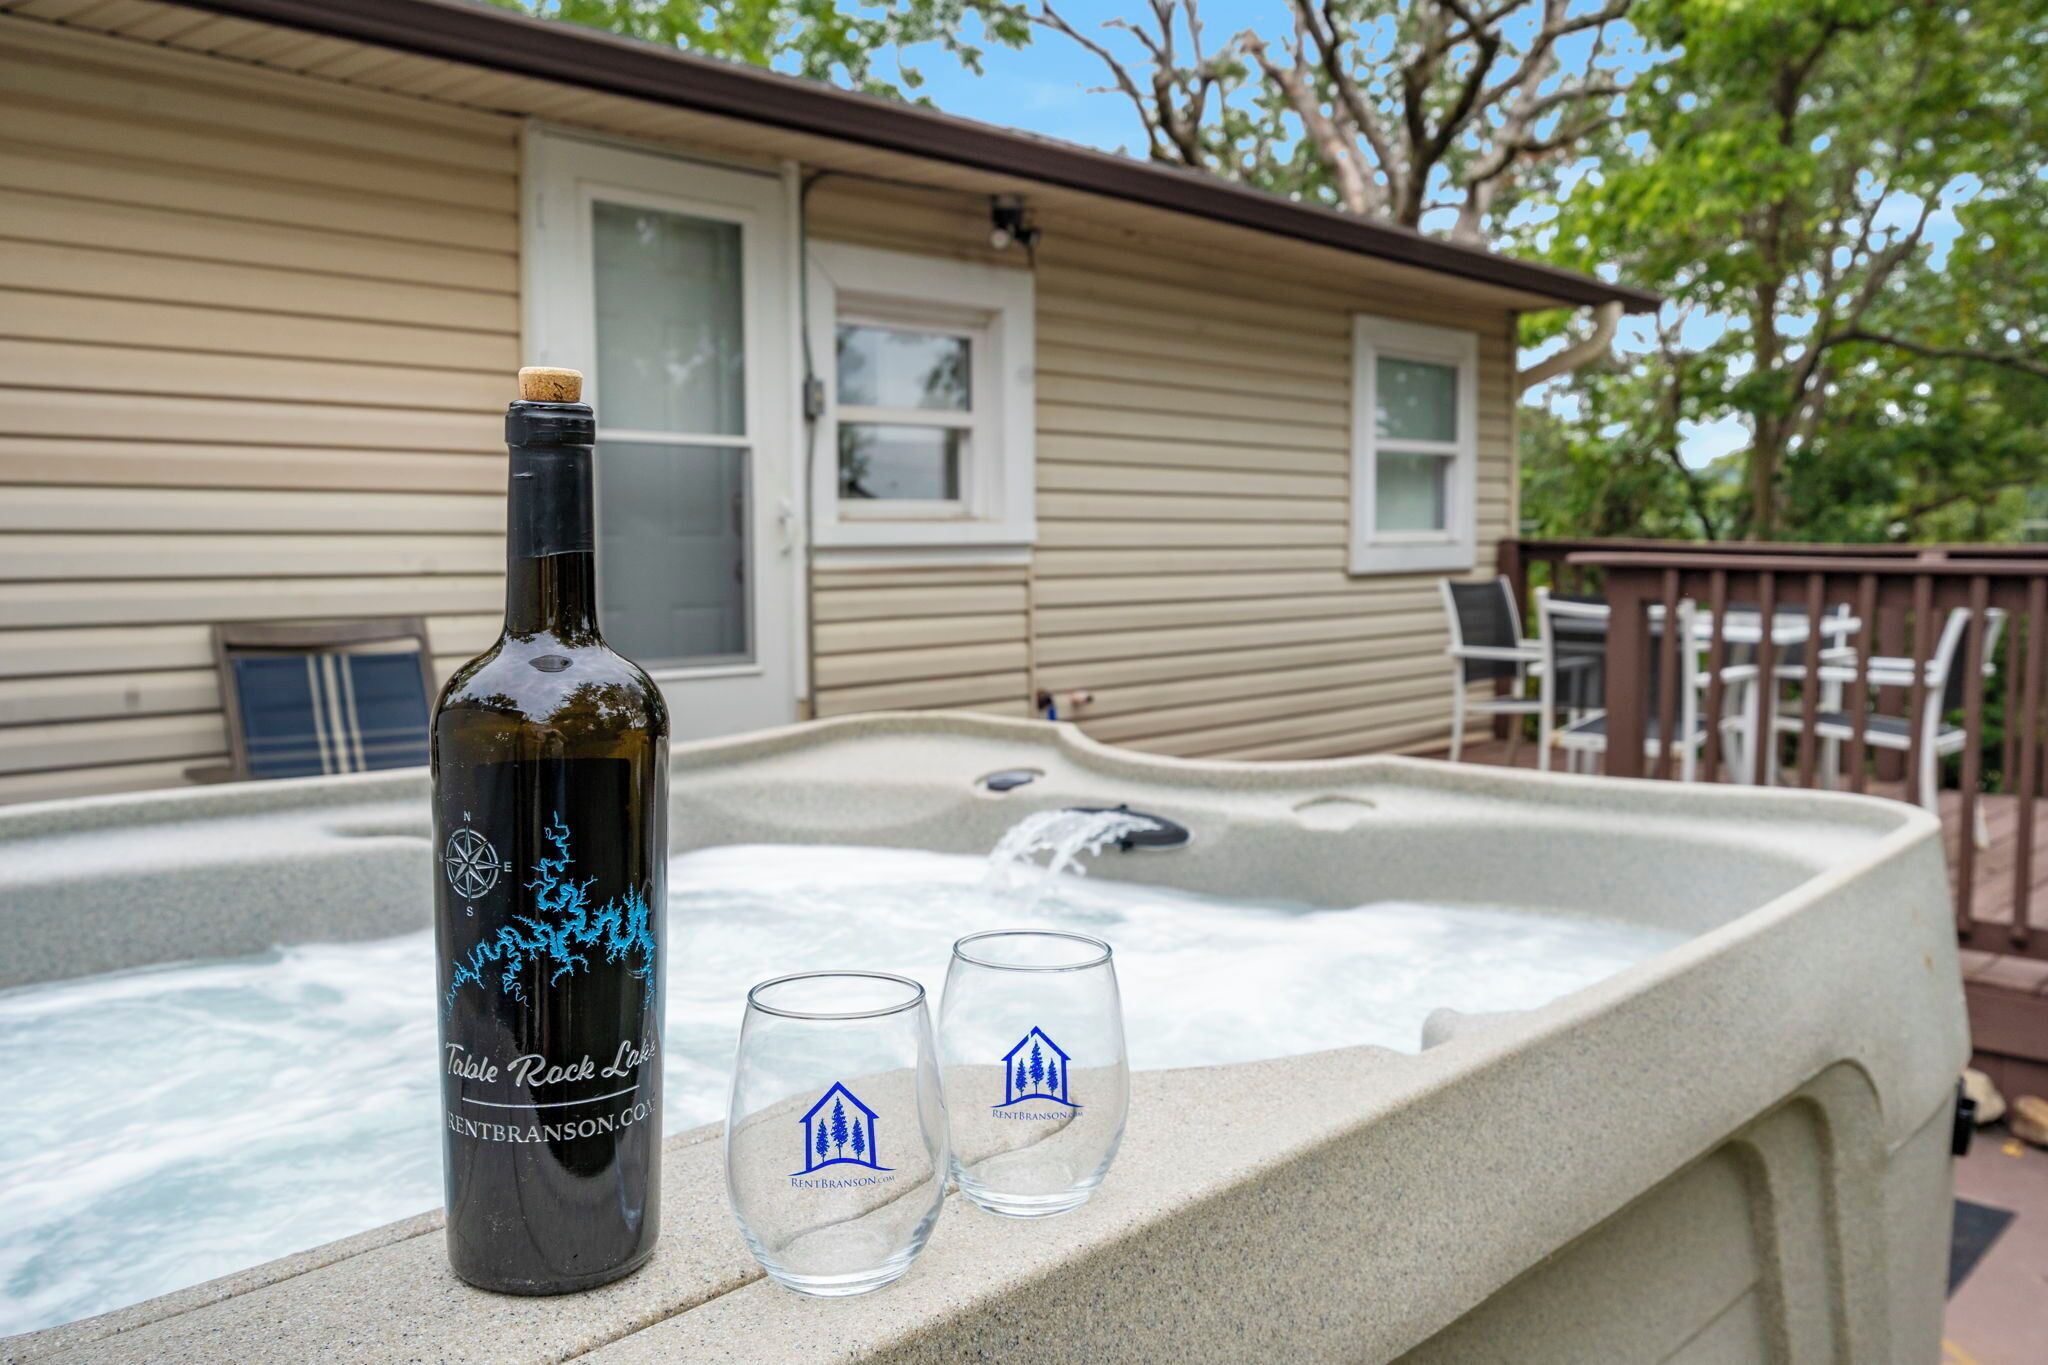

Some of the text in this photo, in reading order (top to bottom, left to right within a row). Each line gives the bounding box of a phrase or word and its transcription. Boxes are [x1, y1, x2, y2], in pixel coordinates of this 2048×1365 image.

[463, 810, 471, 822] N
[504, 861, 513, 873] E
[466, 906, 474, 917] S
[445, 1039, 656, 1088] Table Rock Lake
